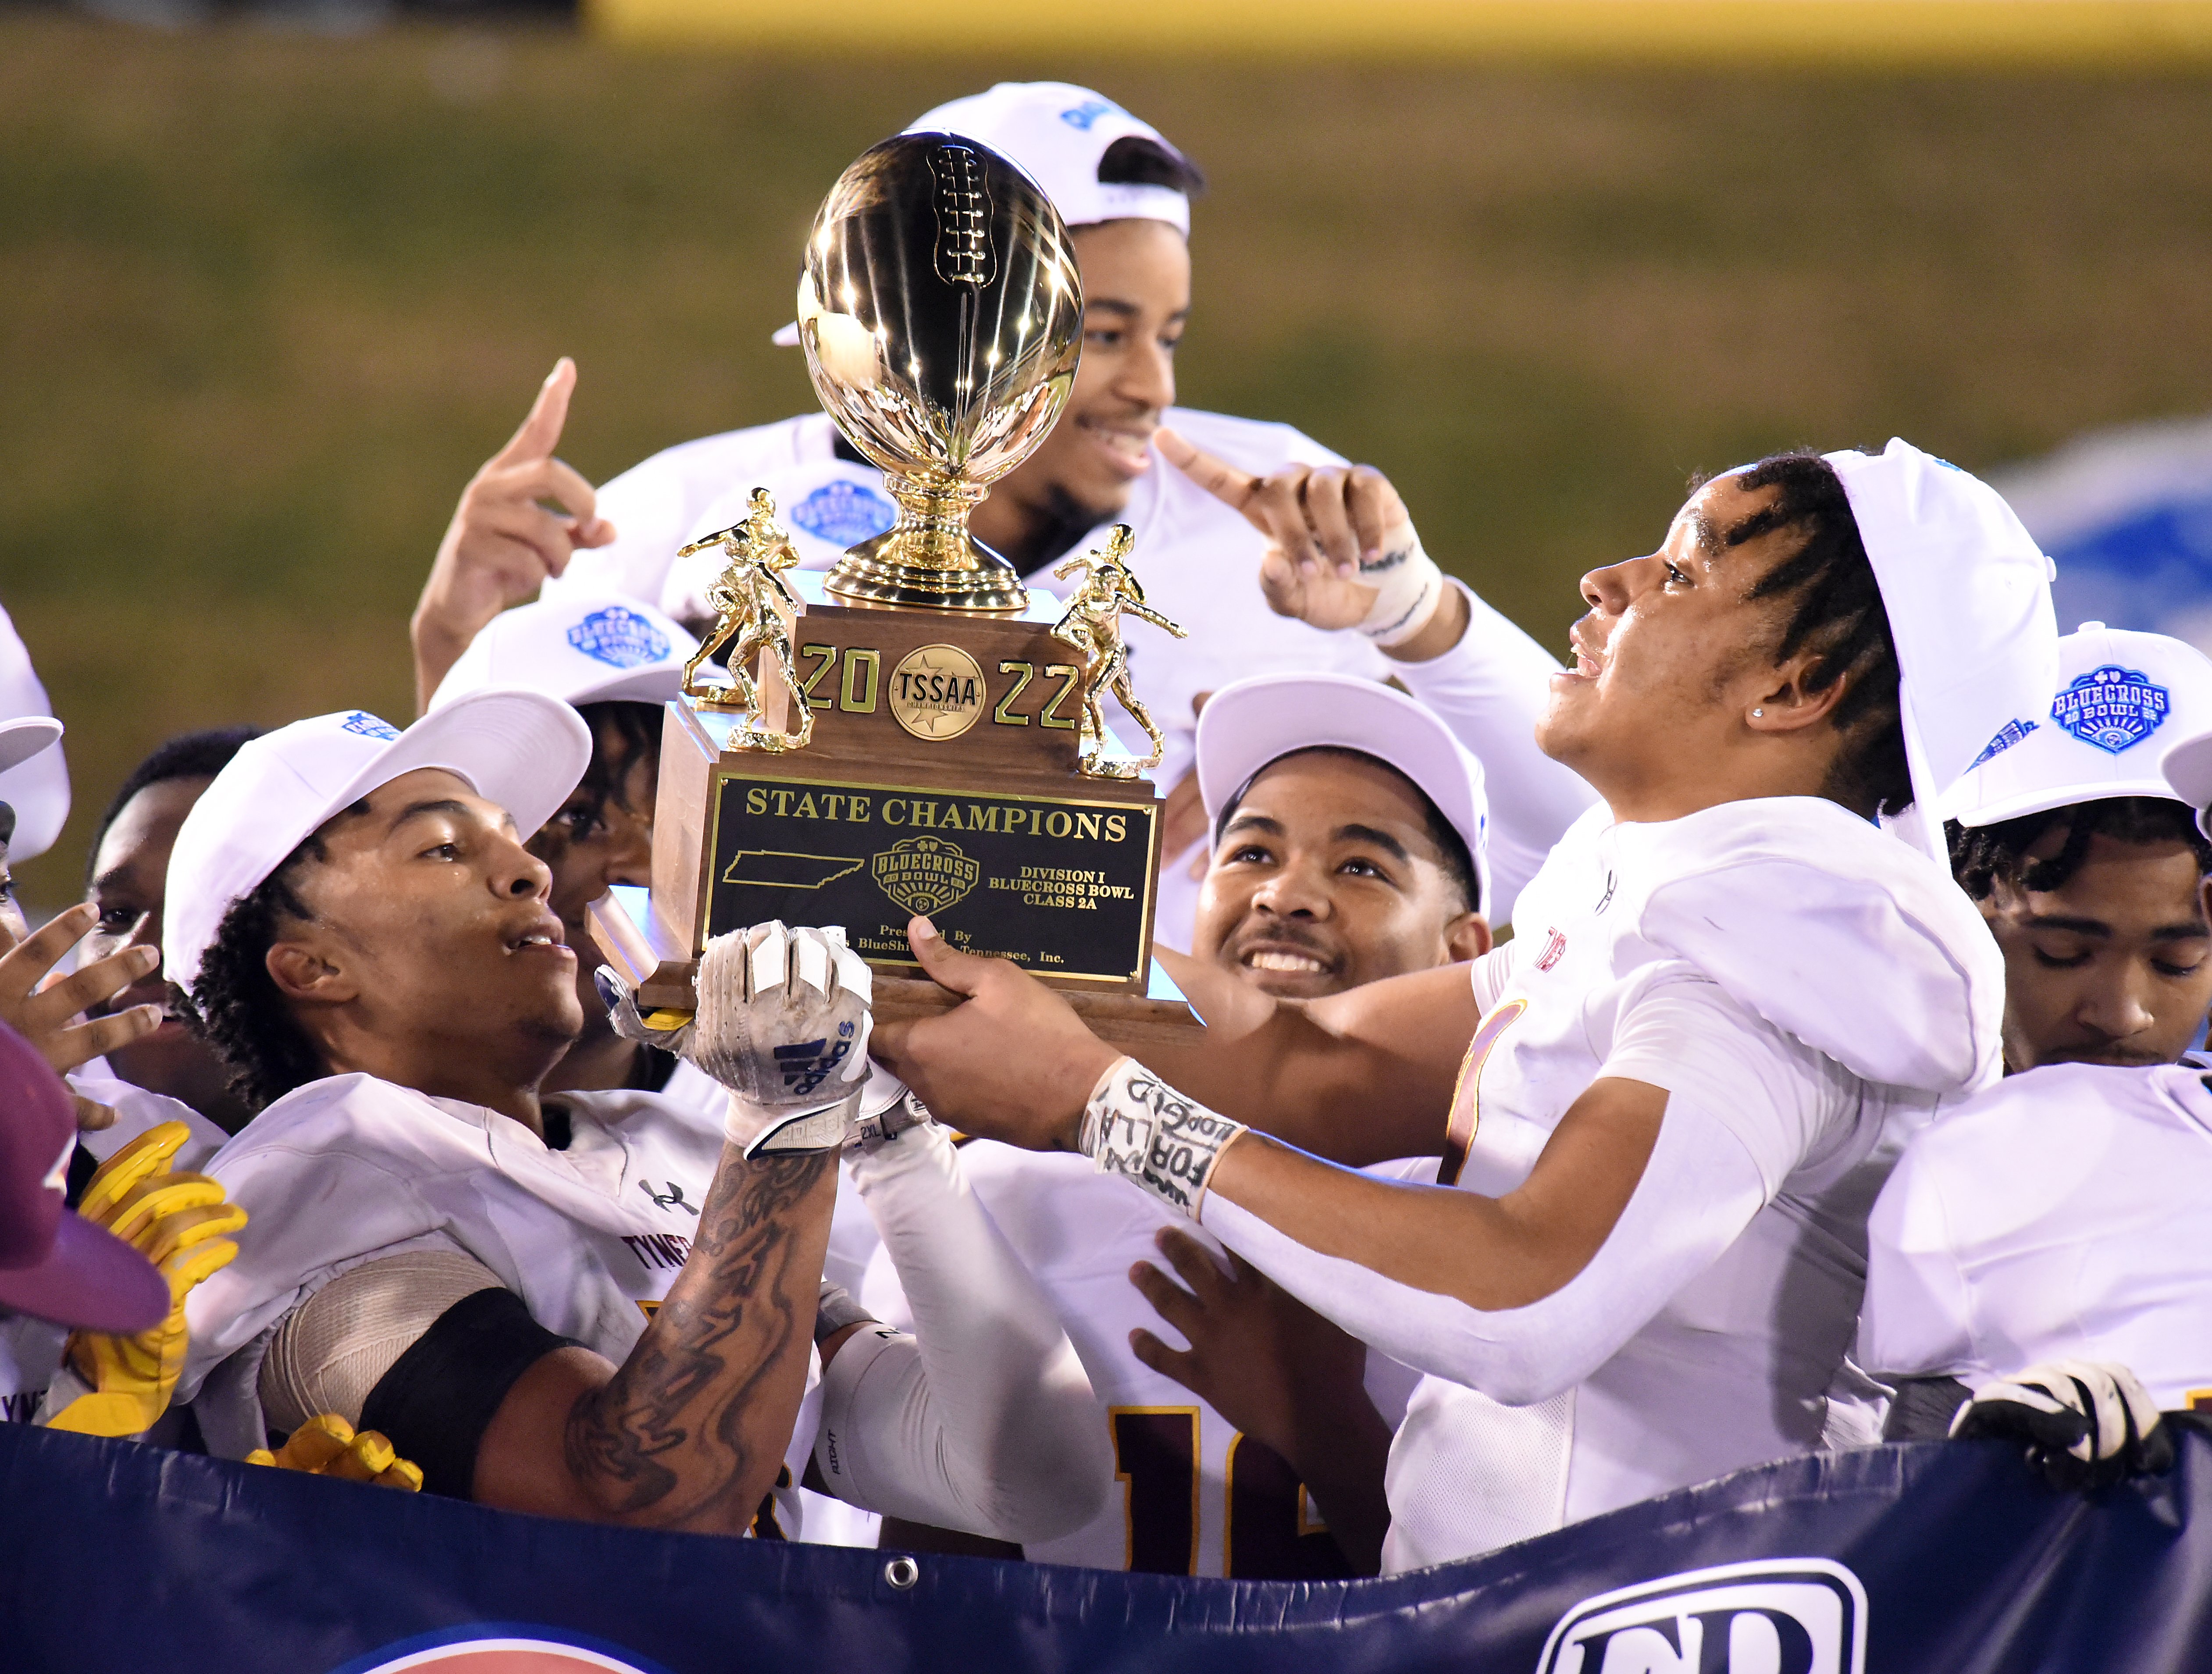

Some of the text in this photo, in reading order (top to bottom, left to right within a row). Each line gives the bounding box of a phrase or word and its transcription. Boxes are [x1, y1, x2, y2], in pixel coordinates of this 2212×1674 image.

[803, 644, 1079, 730] 20 22
[900, 673, 976, 705] TSSAA
[908, 702, 965, 712] CHAMPIONSHIPS
[2054, 684, 2166, 716] BLUECROSS
[2083, 704, 2139, 719] BOWL
[746, 788, 1126, 842] STATE CHAMPIONS
[877, 853, 974, 881] BLUECROSS
[901, 871, 948, 885] BOWL
[1020, 866, 1106, 884] DIVISION I
[988, 877, 1135, 900] BLUECROSS BOWL
[1023, 894, 1097, 910] CLASS 2A
[954, 930, 972, 944] By
[960, 945, 1031, 962] Tennessee,
[1039, 951, 1065, 964] Inc.
[794, 1021, 855, 1095] adidas
[861, 1124, 881, 1140] 2XL
[1151, 1134, 1212, 1187] FOR
[827, 1428, 841, 1475] RIGHT
